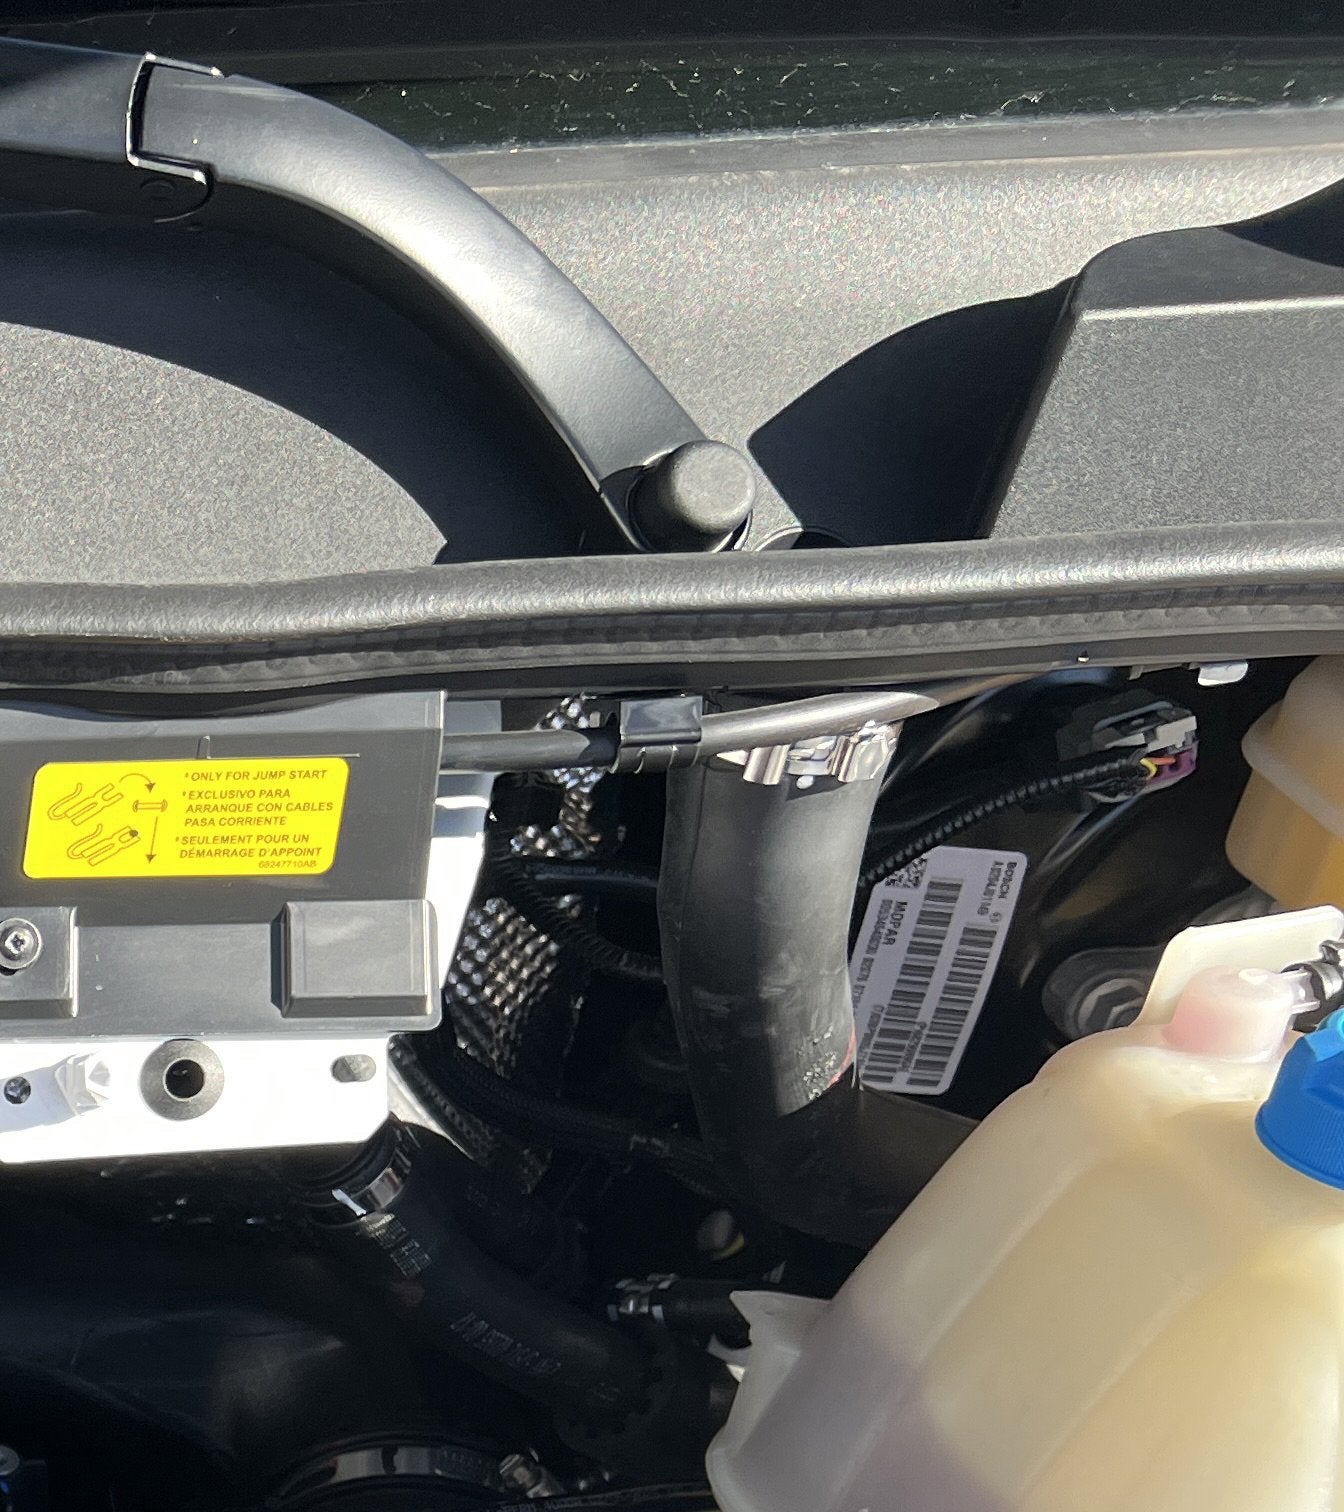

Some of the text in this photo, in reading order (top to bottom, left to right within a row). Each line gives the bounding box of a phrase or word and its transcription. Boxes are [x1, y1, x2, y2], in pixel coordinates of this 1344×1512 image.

[191, 769, 328, 782] ONLY FOR JUMP START
[188, 788, 291, 800] EXCLUSIVO PARA
[186, 801, 334, 813] ARRANQUE CON CABLES
[184, 816, 287, 827] PASA CORRIENTE
[181, 834, 310, 845] SEULEMENT POUR UN
[179, 846, 322, 859] DÉMARRAGE D'APPOINT
[883, 900, 908, 946] MOPAR
